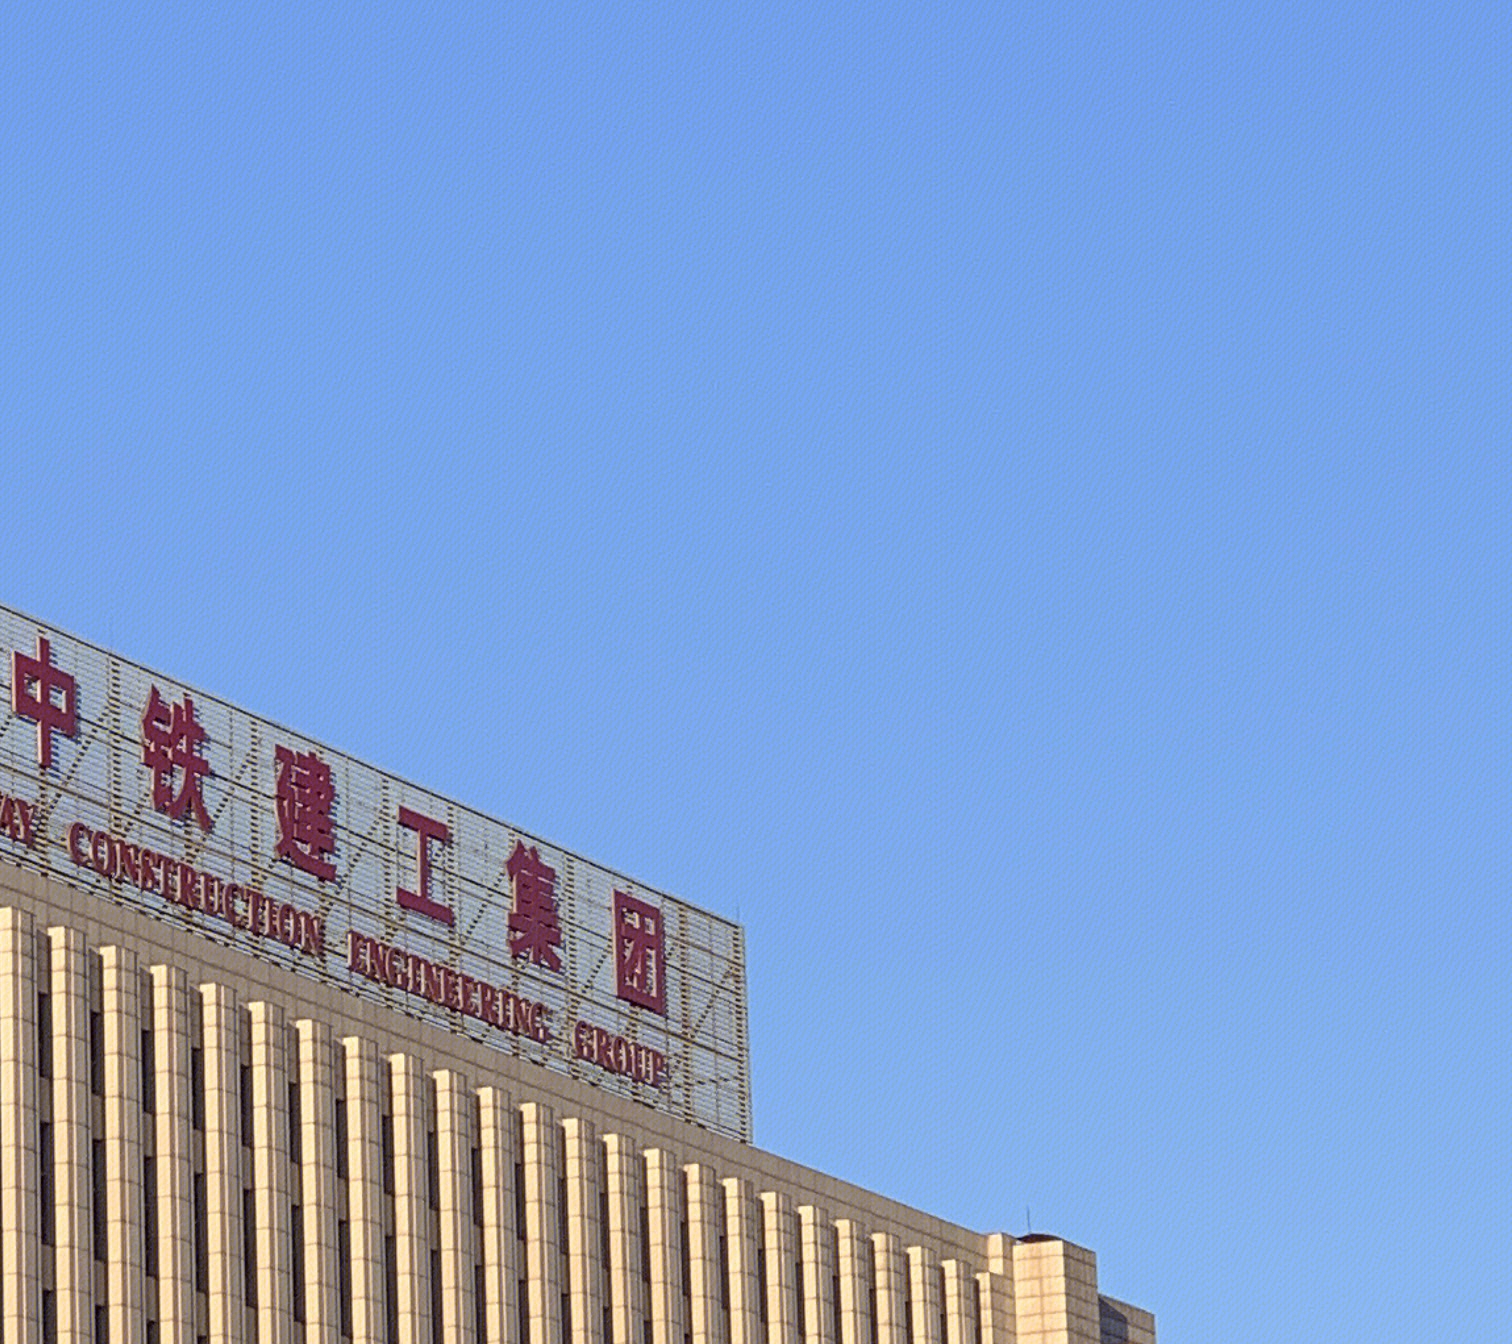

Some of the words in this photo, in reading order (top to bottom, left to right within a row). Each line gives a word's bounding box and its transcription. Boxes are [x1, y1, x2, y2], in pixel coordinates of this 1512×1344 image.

[67, 822, 326, 955] CONSTRUCTION
[346, 930, 552, 1044] ENGINEERING
[572, 1020, 666, 1088] GROUP
